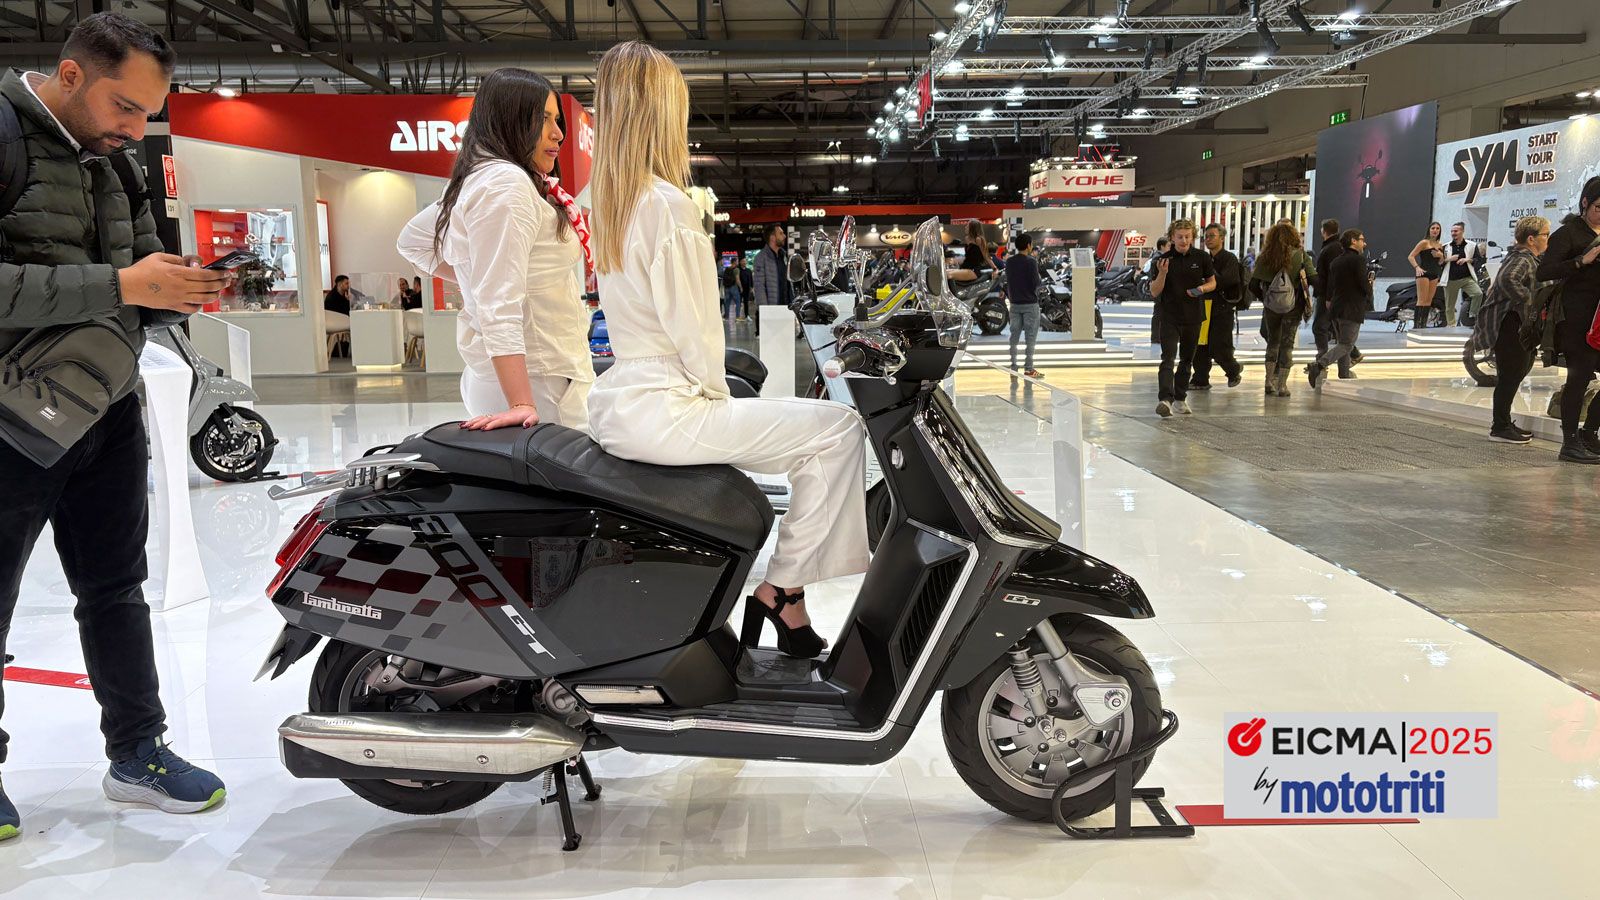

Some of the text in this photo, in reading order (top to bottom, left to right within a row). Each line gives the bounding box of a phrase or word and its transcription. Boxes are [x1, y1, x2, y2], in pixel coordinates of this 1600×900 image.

[1528, 132, 1559, 148] START
[1526, 151, 1553, 166] YOUR
[1447, 139, 1524, 205] SYM
[1526, 169, 1555, 184] MILES
[1032, 177, 1048, 191] YOHE
[1061, 175, 1124, 186] YOHE
[801, 208, 826, 218] Hero
[1510, 207, 1538, 218] ADX 300
[302, 591, 382, 620] Lambretta
[1003, 593, 1041, 606] GT
